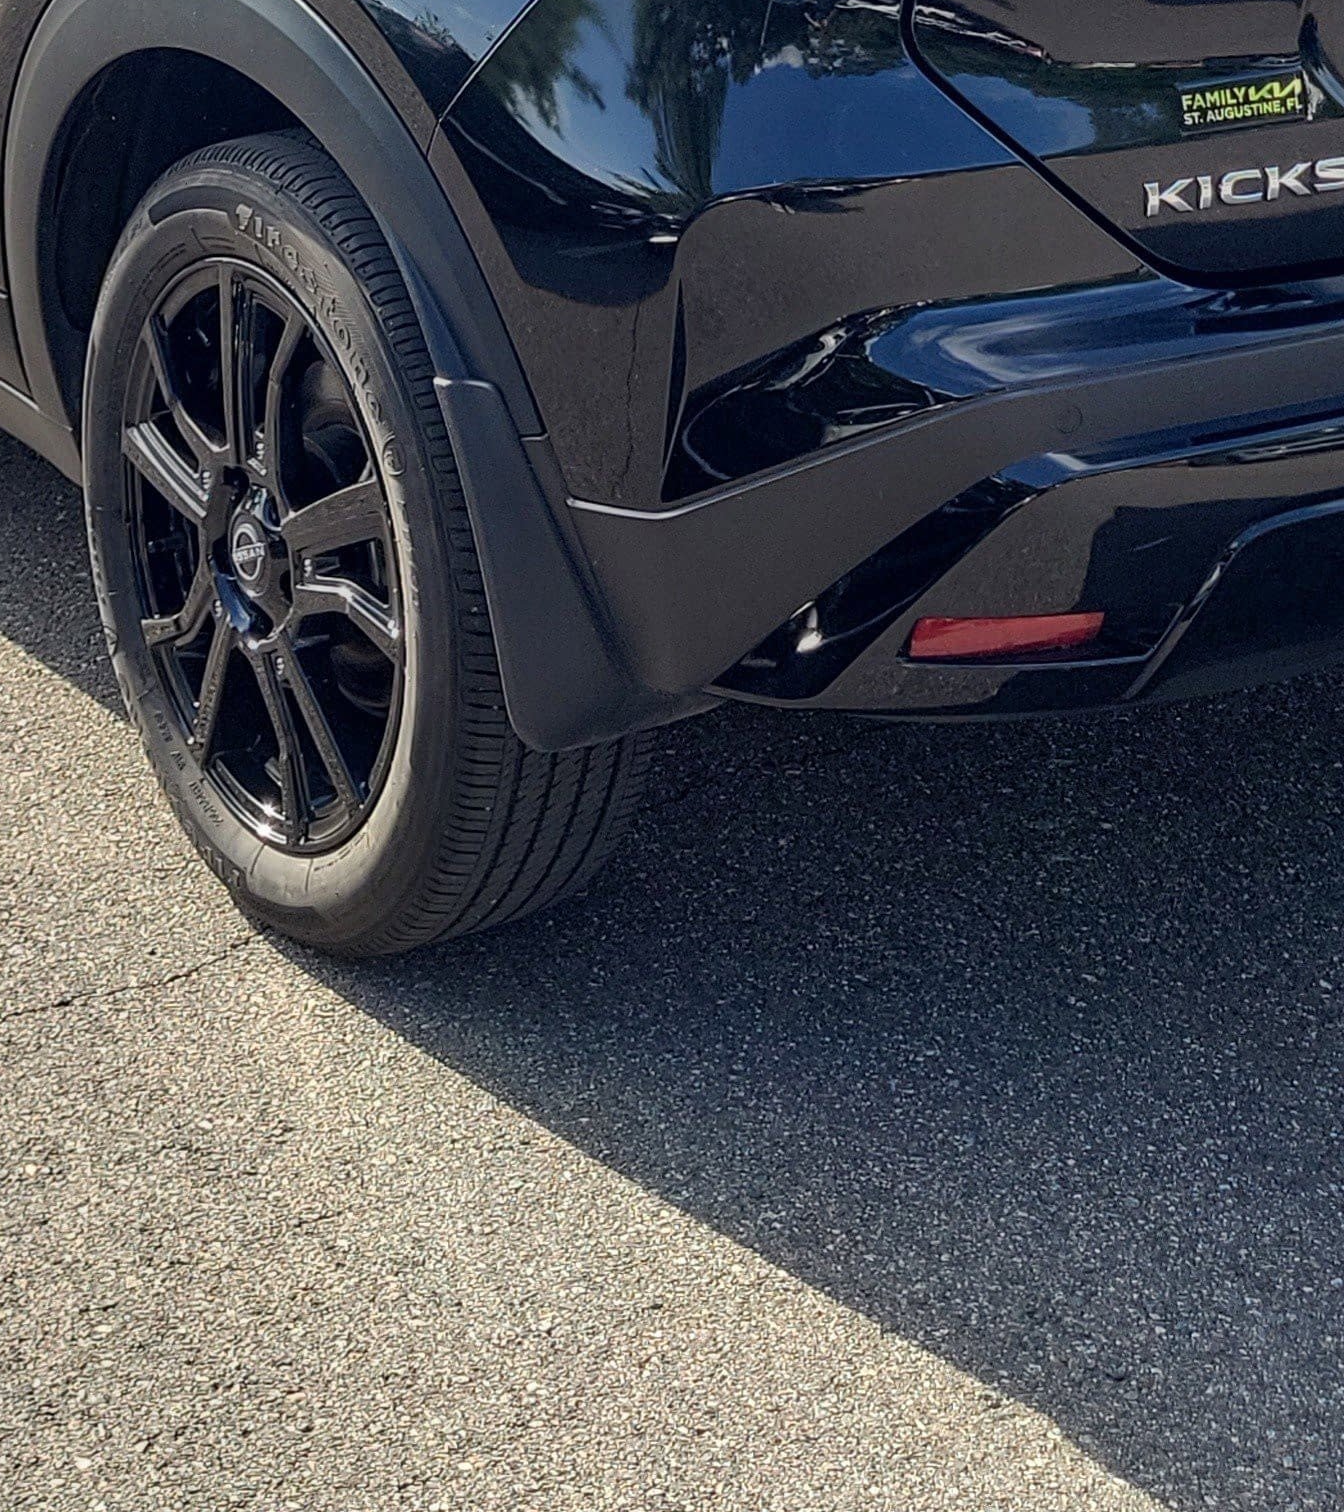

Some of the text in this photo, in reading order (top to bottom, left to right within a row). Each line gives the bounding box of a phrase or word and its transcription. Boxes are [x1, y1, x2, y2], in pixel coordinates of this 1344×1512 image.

[1181, 77, 1303, 111] FAMILY KIA
[1183, 97, 1303, 125] ST. AUGUSTINE, FL
